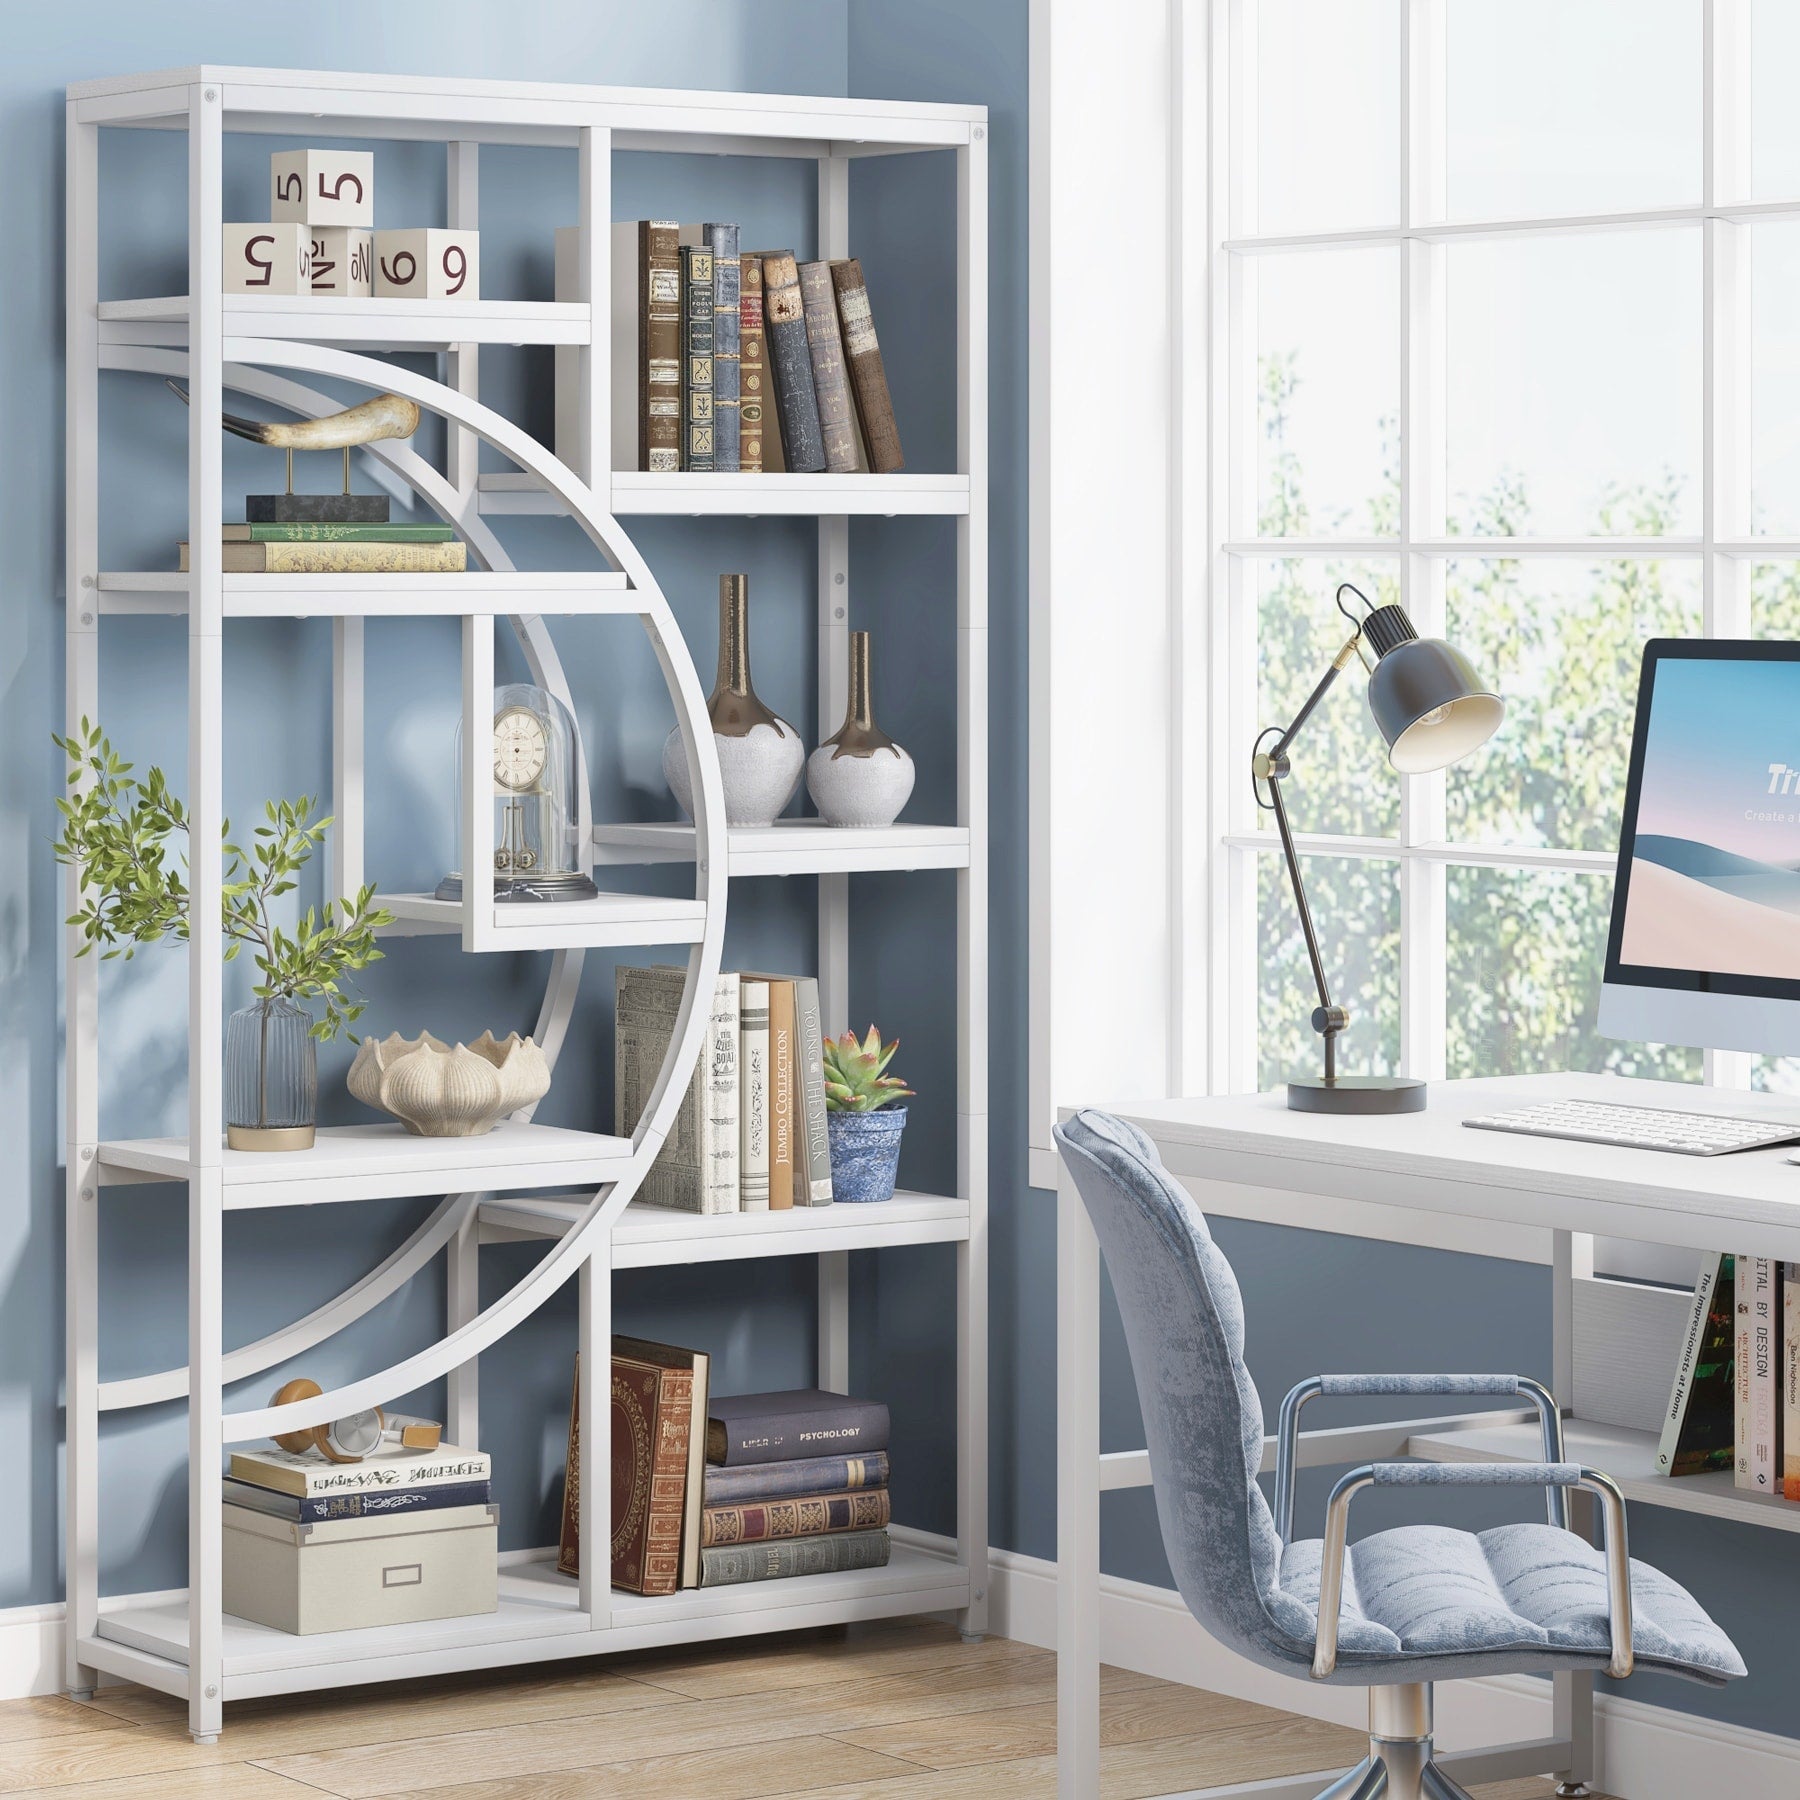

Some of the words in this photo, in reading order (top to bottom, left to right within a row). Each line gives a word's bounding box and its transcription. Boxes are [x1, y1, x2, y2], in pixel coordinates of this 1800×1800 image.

[277, 172, 302, 202] 5
[319, 173, 363, 204] 5
[244, 235, 275, 286] 5
[1744, 809, 1785, 823] Create
[1787, 813, 1794, 823] a
[804, 1006, 819, 1061] YOUNG
[775, 1028, 788, 1114] COLLECTION
[807, 1075, 823, 1107] THE
[775, 1118, 791, 1165] JUMBO
[809, 1110, 826, 1161] SHACK
[1700, 1272, 1712, 1293] The
[1756, 1301, 1768, 1319] BY
[1681, 1294, 1706, 1372] Impressionists
[1756, 1327, 1768, 1378] DESIGN
[1678, 1374, 1686, 1387] at
[1670, 1389, 1683, 1420] Home
[800, 1427, 860, 1441] PSYCHOLOGY
